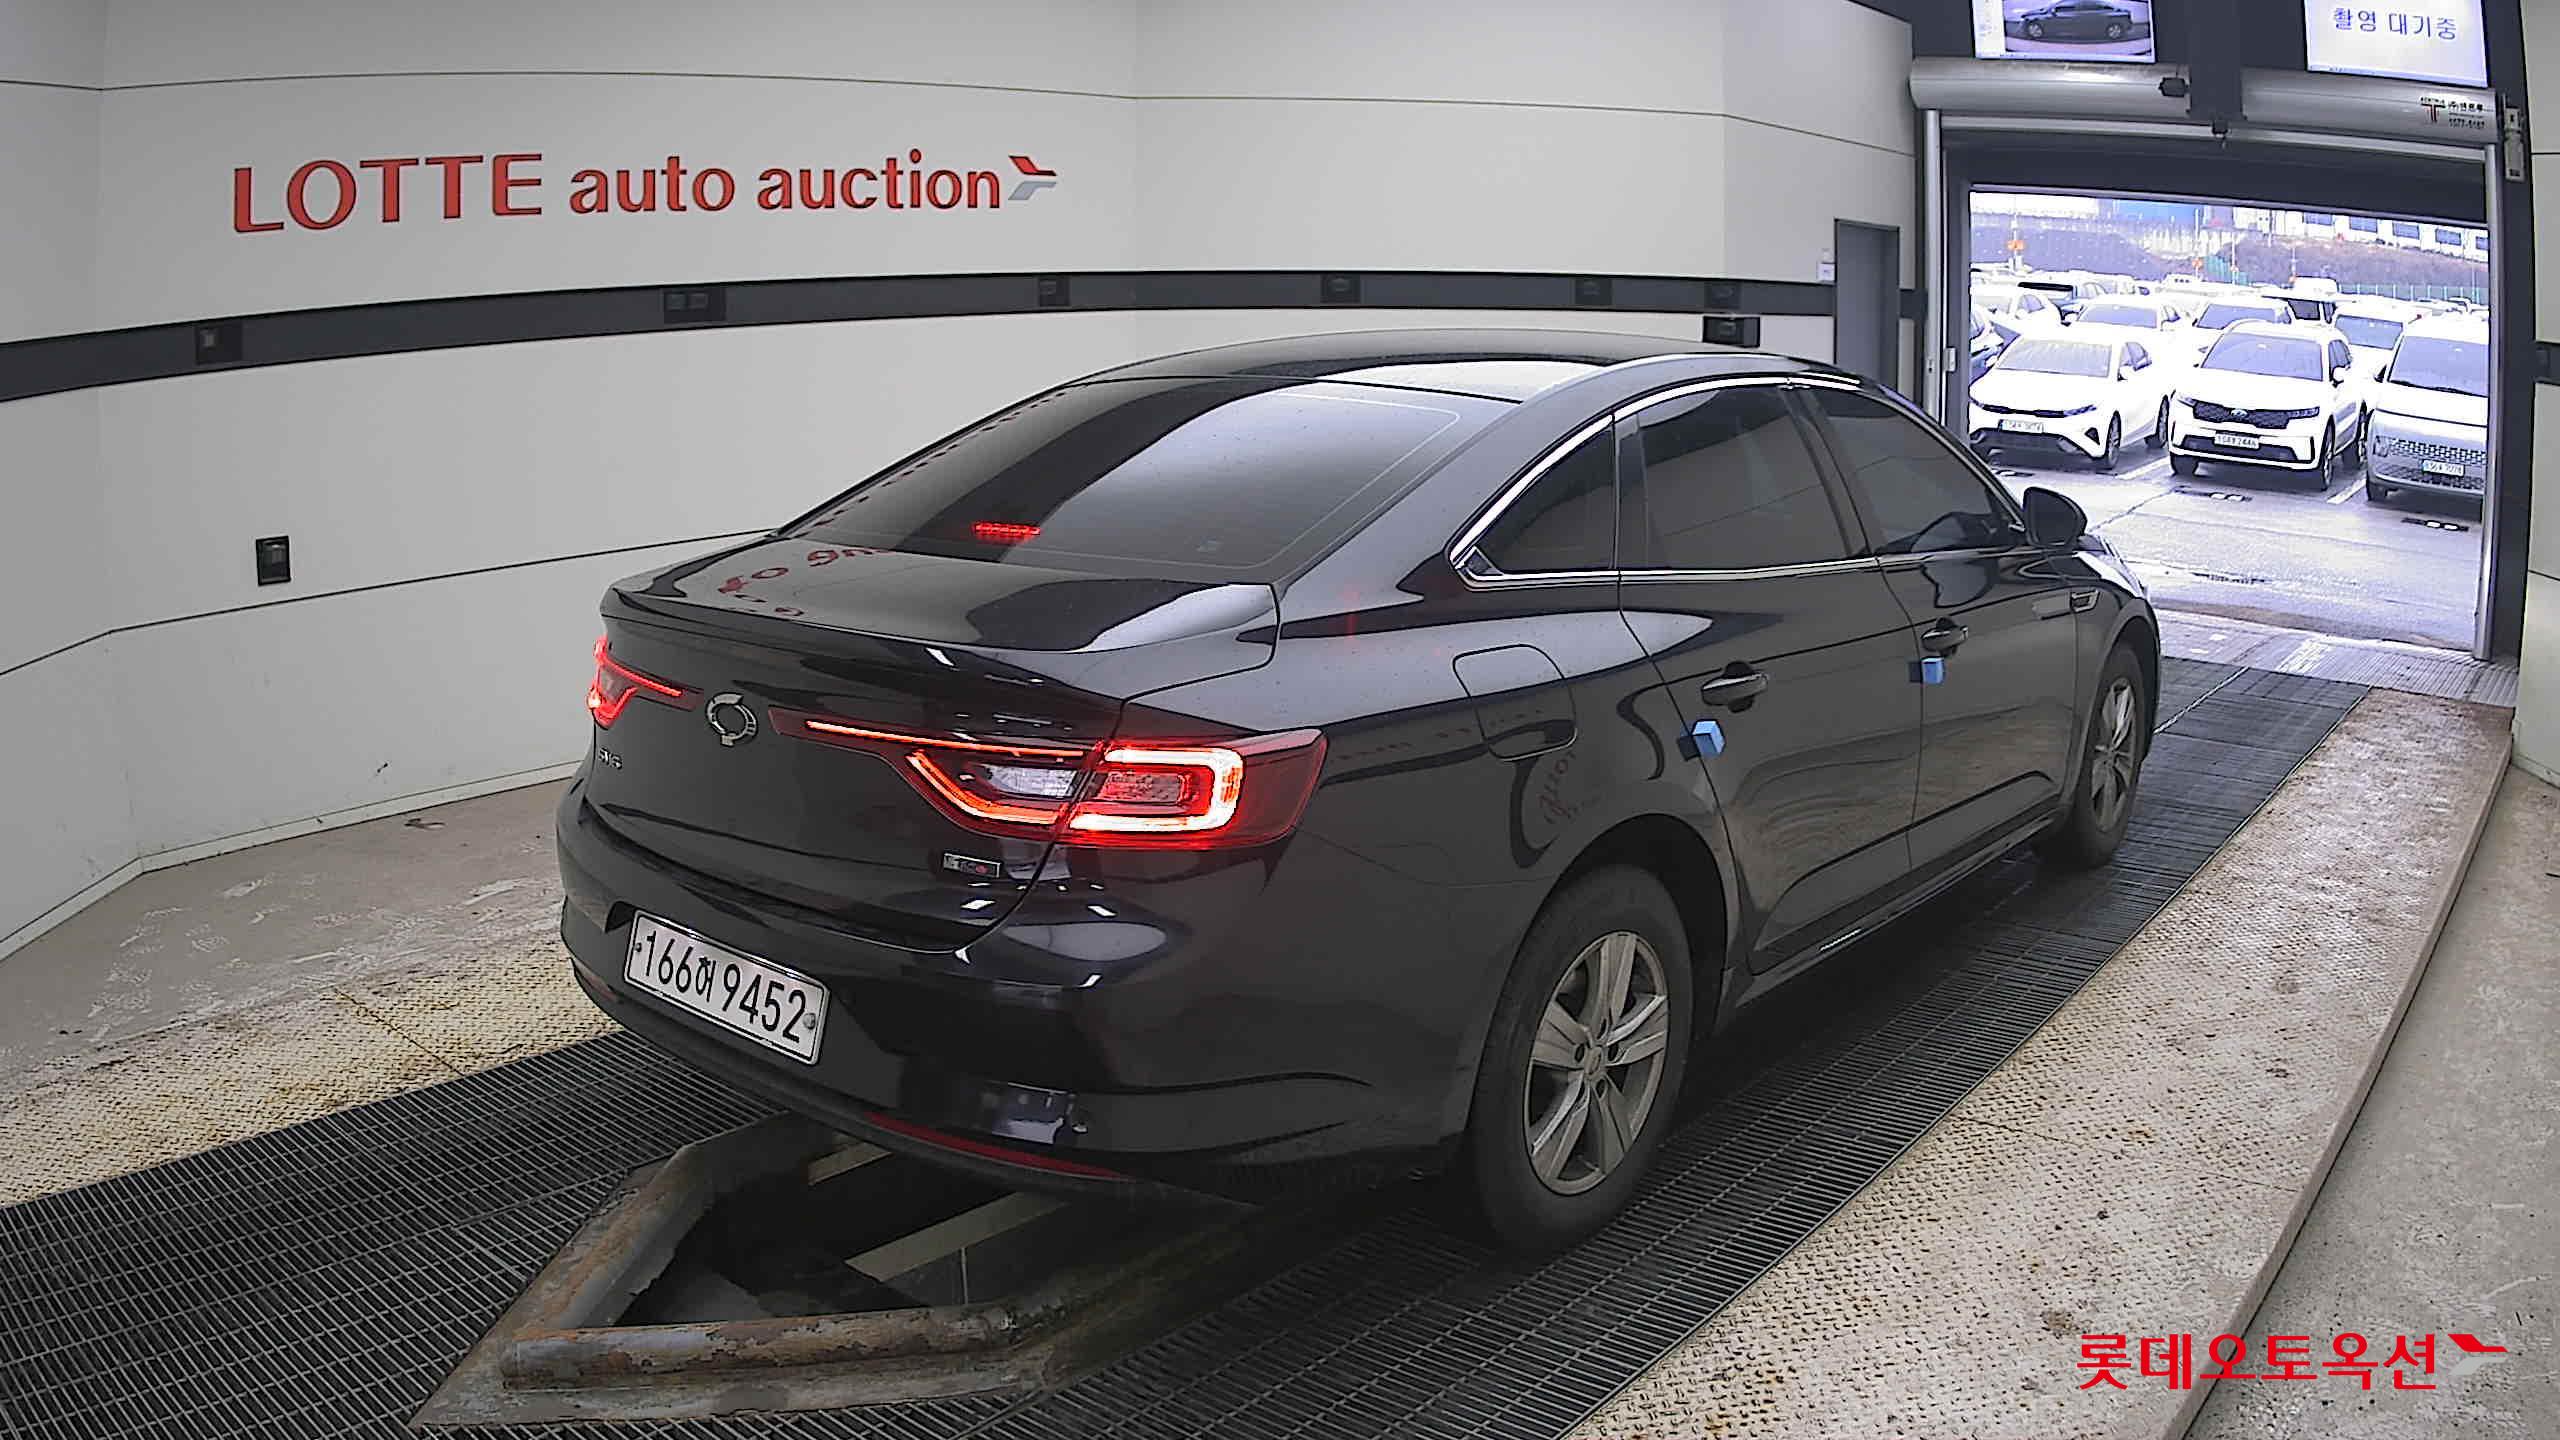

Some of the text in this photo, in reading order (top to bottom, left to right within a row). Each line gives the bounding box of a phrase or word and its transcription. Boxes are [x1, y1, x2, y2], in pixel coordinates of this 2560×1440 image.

[2388, 13, 2457, 40] 대기중
[234, 149, 1001, 232] LOTTE auto auction
[722, 963, 806, 1044] 9452
